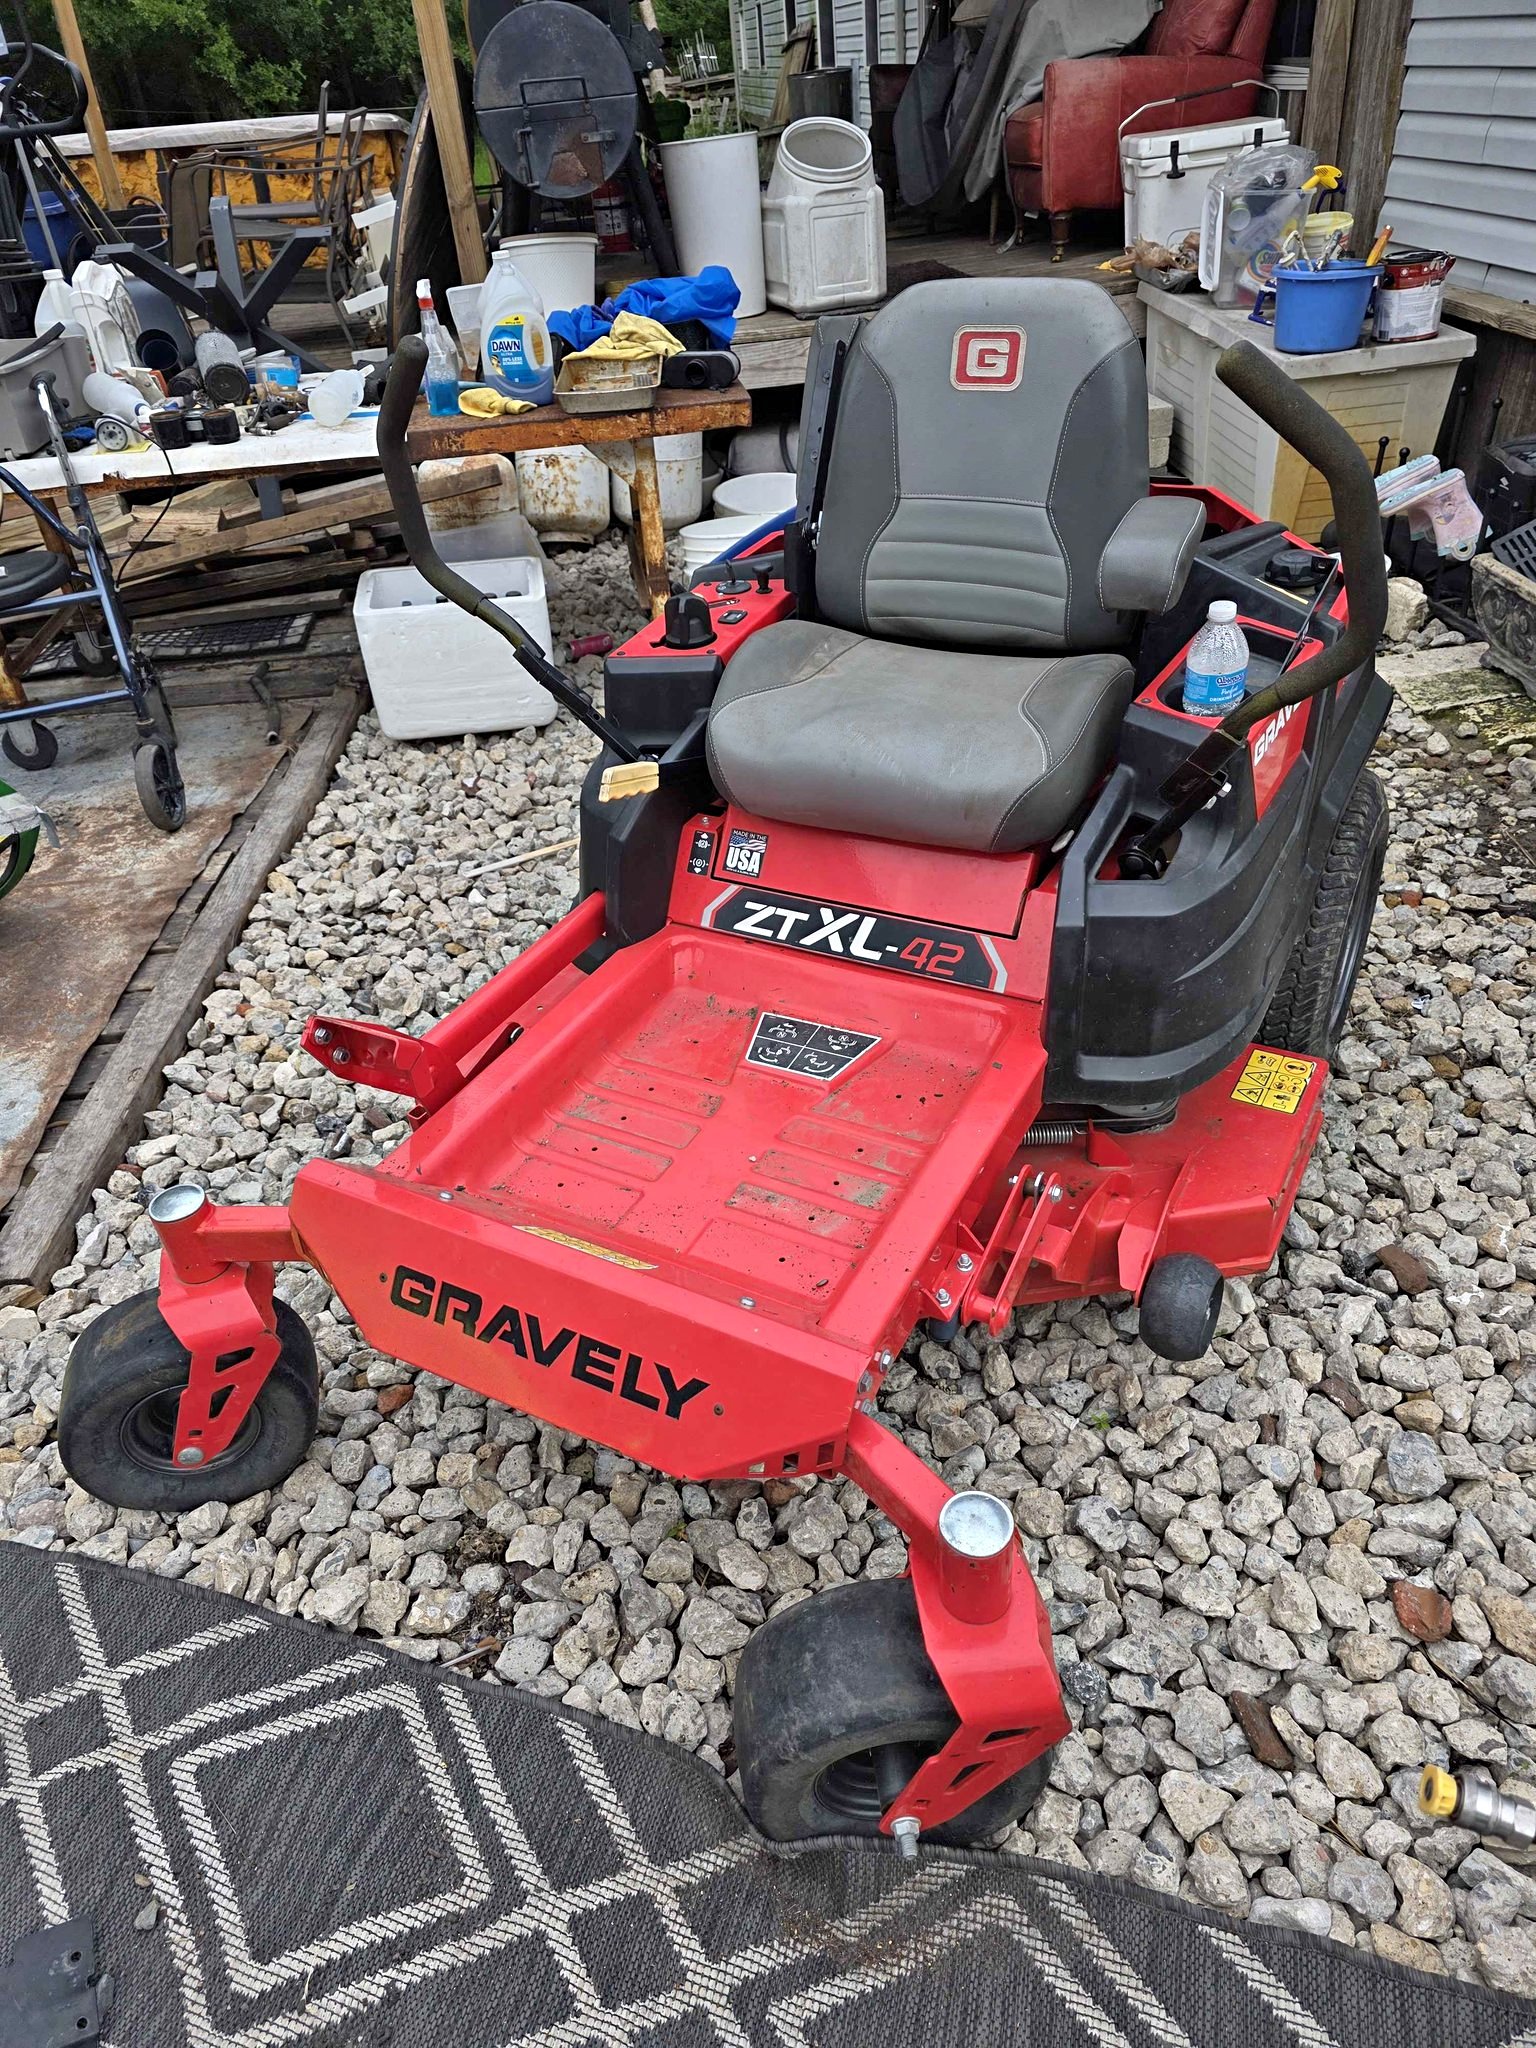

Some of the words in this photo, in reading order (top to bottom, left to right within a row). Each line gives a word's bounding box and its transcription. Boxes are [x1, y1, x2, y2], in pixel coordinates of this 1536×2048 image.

[492, 341, 521, 352] DAWN
[966, 338, 1010, 377] G
[1254, 701, 1302, 767] GRAV
[733, 830, 749, 838] MADE
[726, 847, 761, 873] USA
[390, 1264, 711, 1421] GRAVELY
